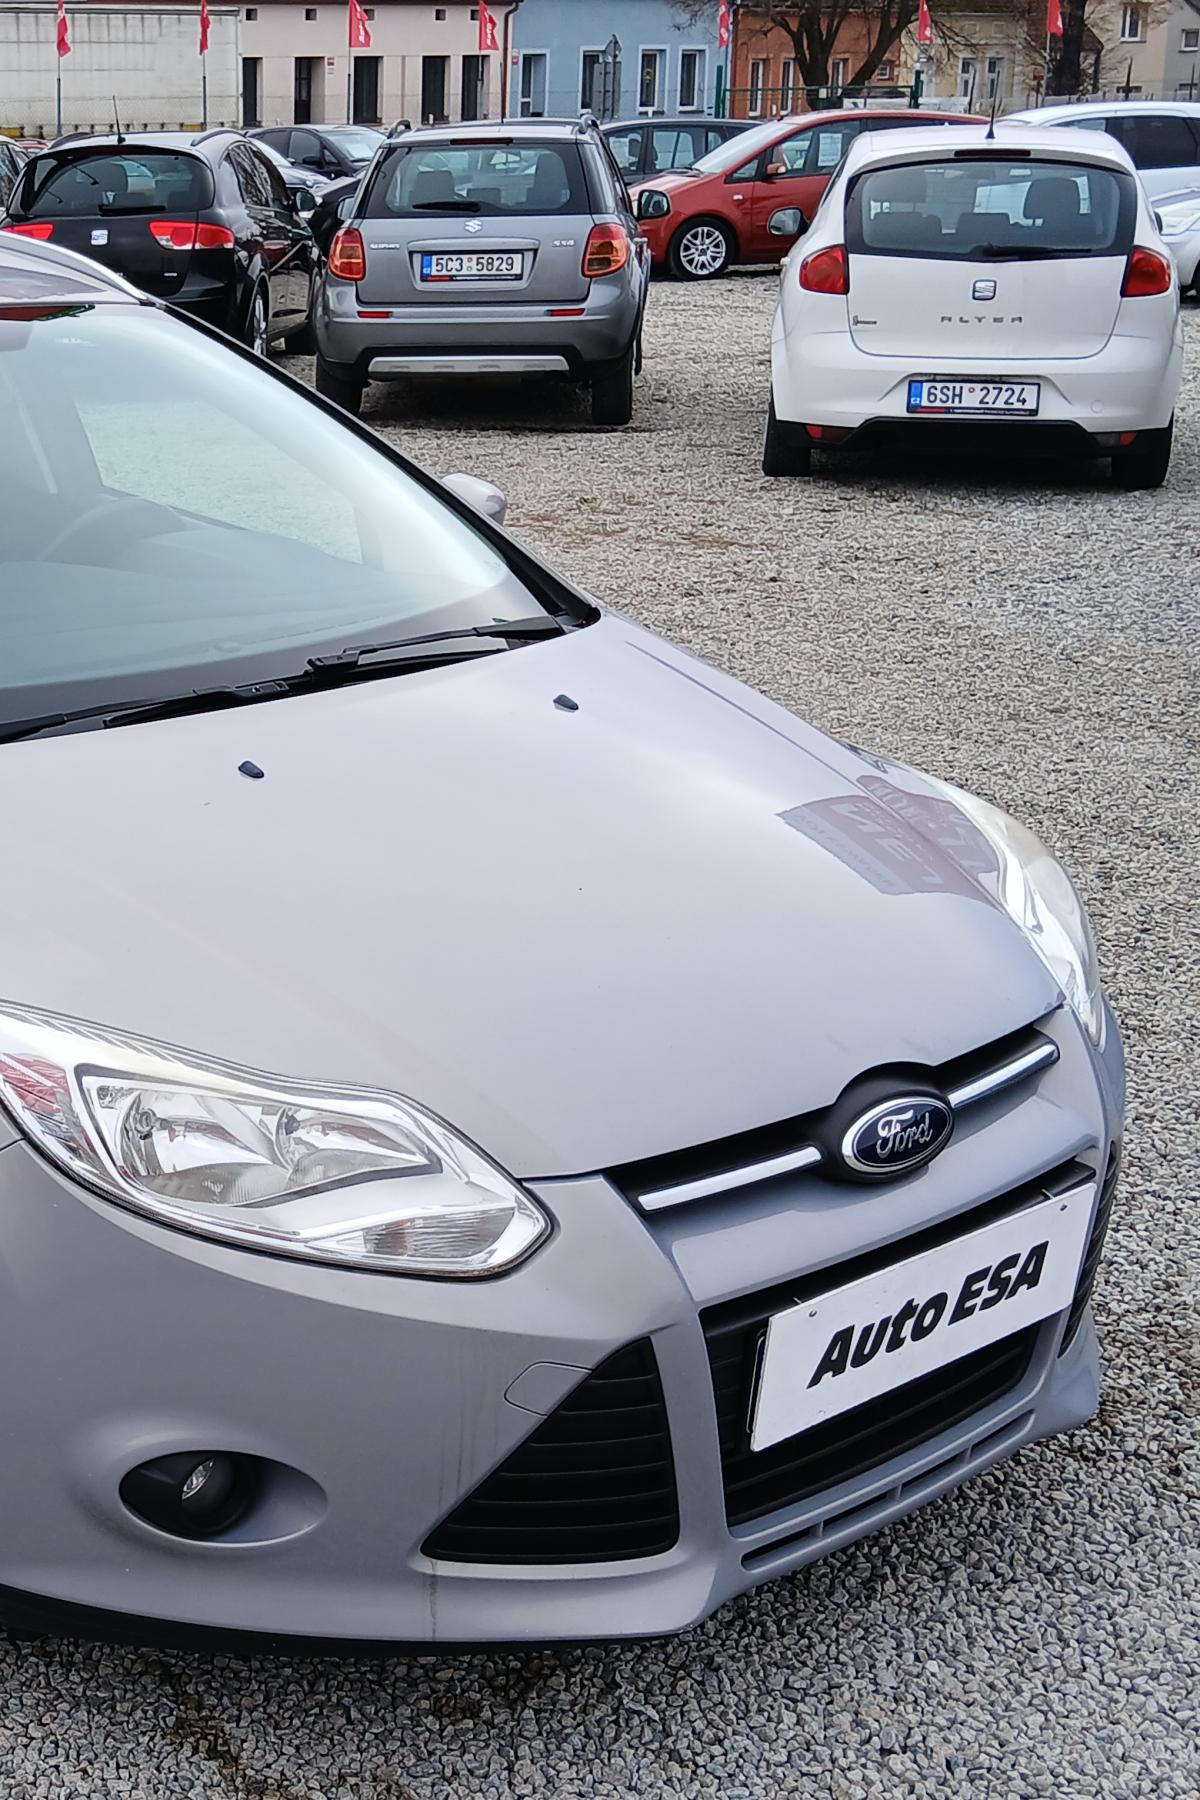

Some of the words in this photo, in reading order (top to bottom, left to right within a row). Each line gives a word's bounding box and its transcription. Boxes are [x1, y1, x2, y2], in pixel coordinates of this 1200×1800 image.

[435, 256, 464, 273] 5C3
[475, 256, 515, 272] 5829
[926, 385, 963, 404] 6SH
[978, 386, 1028, 406] 2724
[876, 1109, 933, 1159] Ford
[805, 1291, 949, 1390] Auto
[947, 1239, 1050, 1327] ESA
